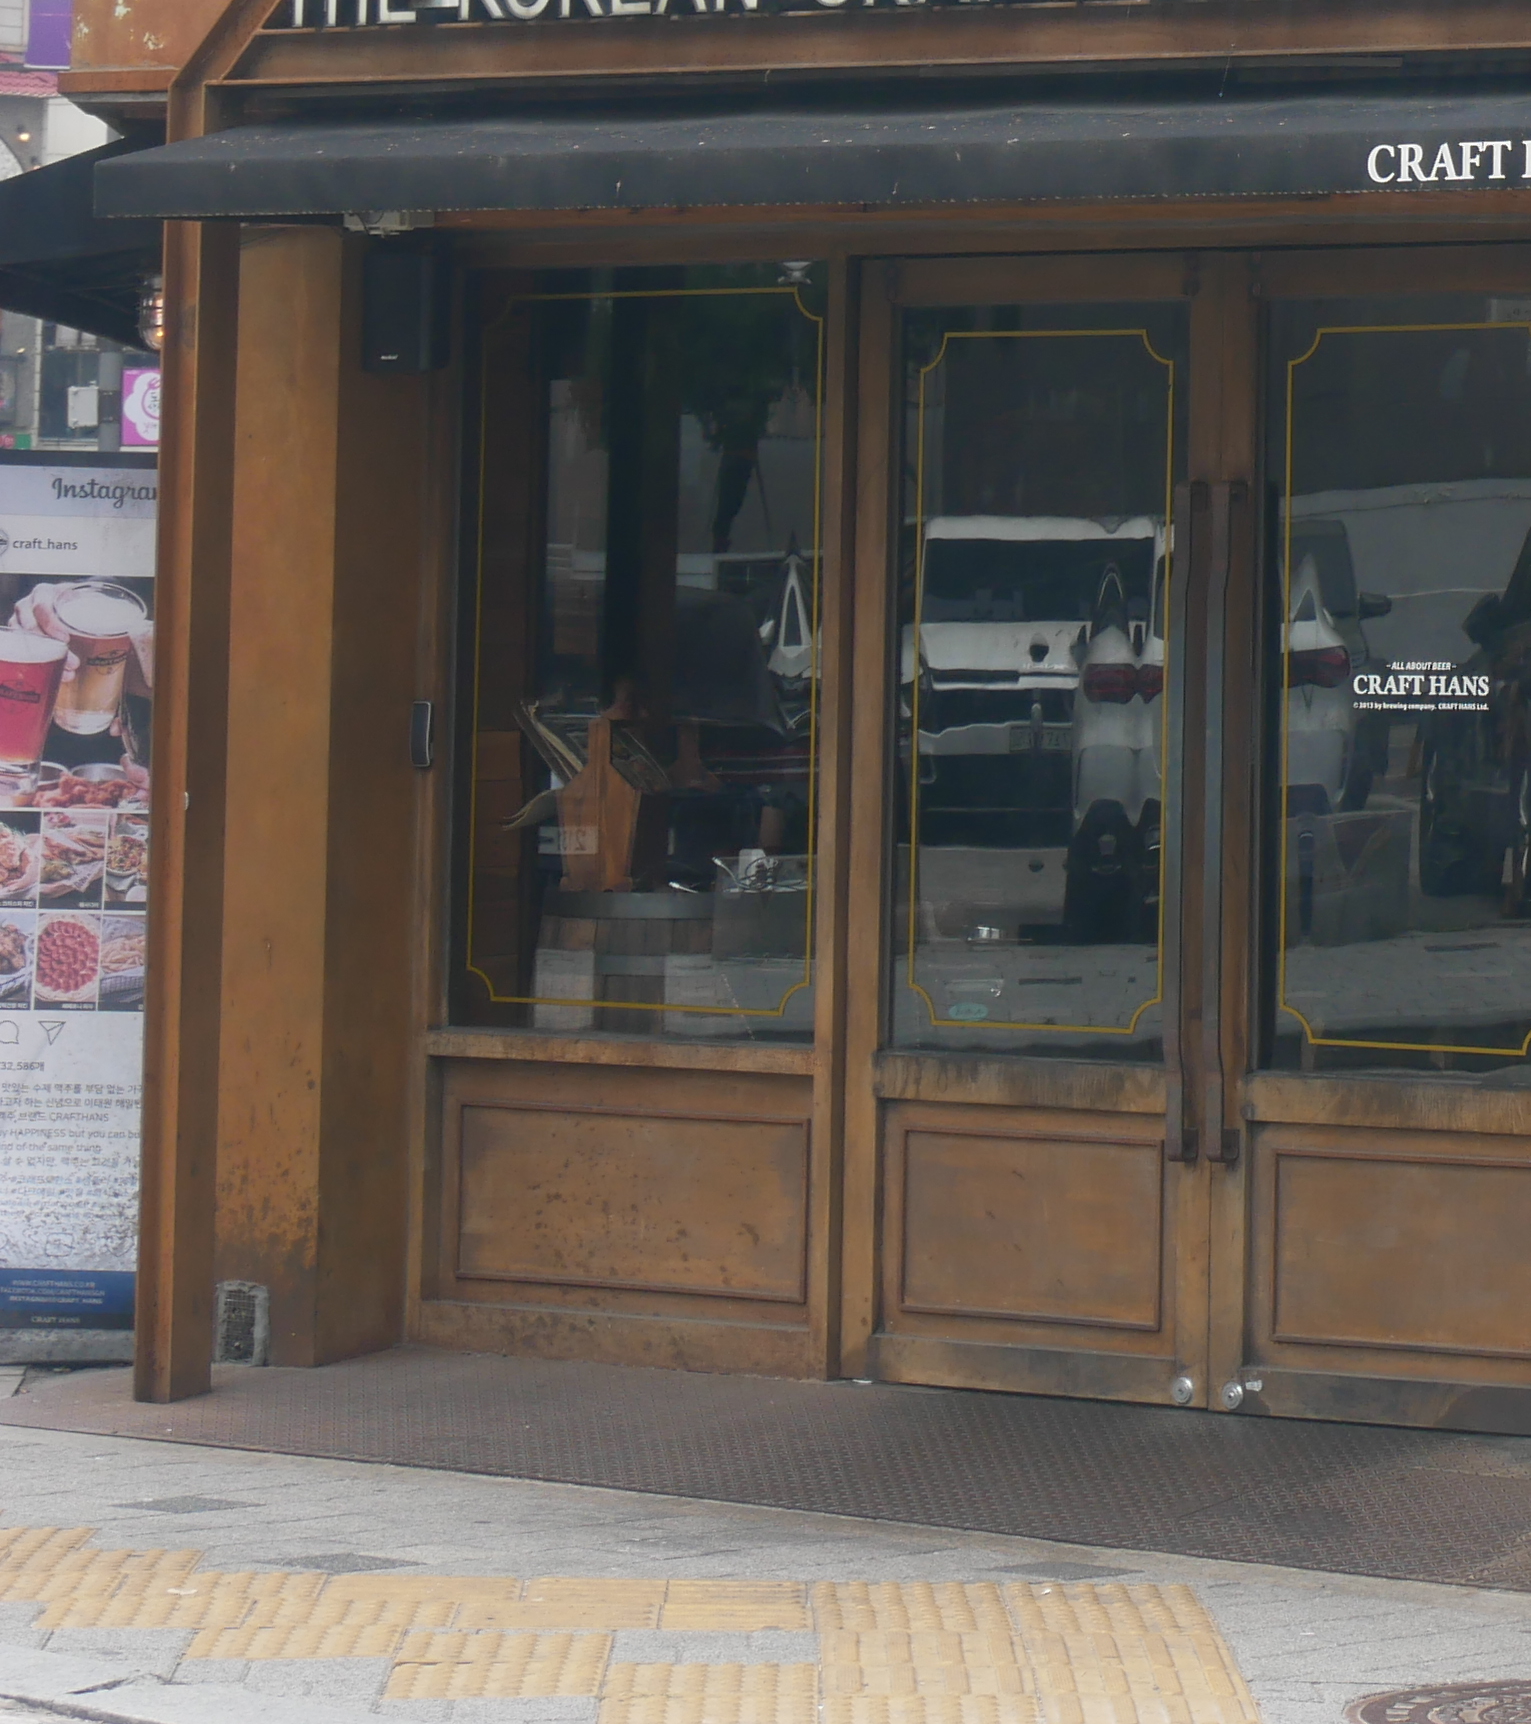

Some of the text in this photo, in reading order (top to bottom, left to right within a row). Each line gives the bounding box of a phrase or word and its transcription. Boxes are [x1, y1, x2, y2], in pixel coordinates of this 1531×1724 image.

[1366, 140, 1513, 186] CRAFT
[12, 538, 79, 551] craft_hans
[1391, 661, 1452, 671] ALL ABOUT BEER
[1353, 674, 1490, 696] CRAFT HANS
[0, 1061, 45, 1072] 32,586개
[49, 1112, 110, 1123] CRAFTHANS
[9, 1128, 66, 1139] HAPPINESS
